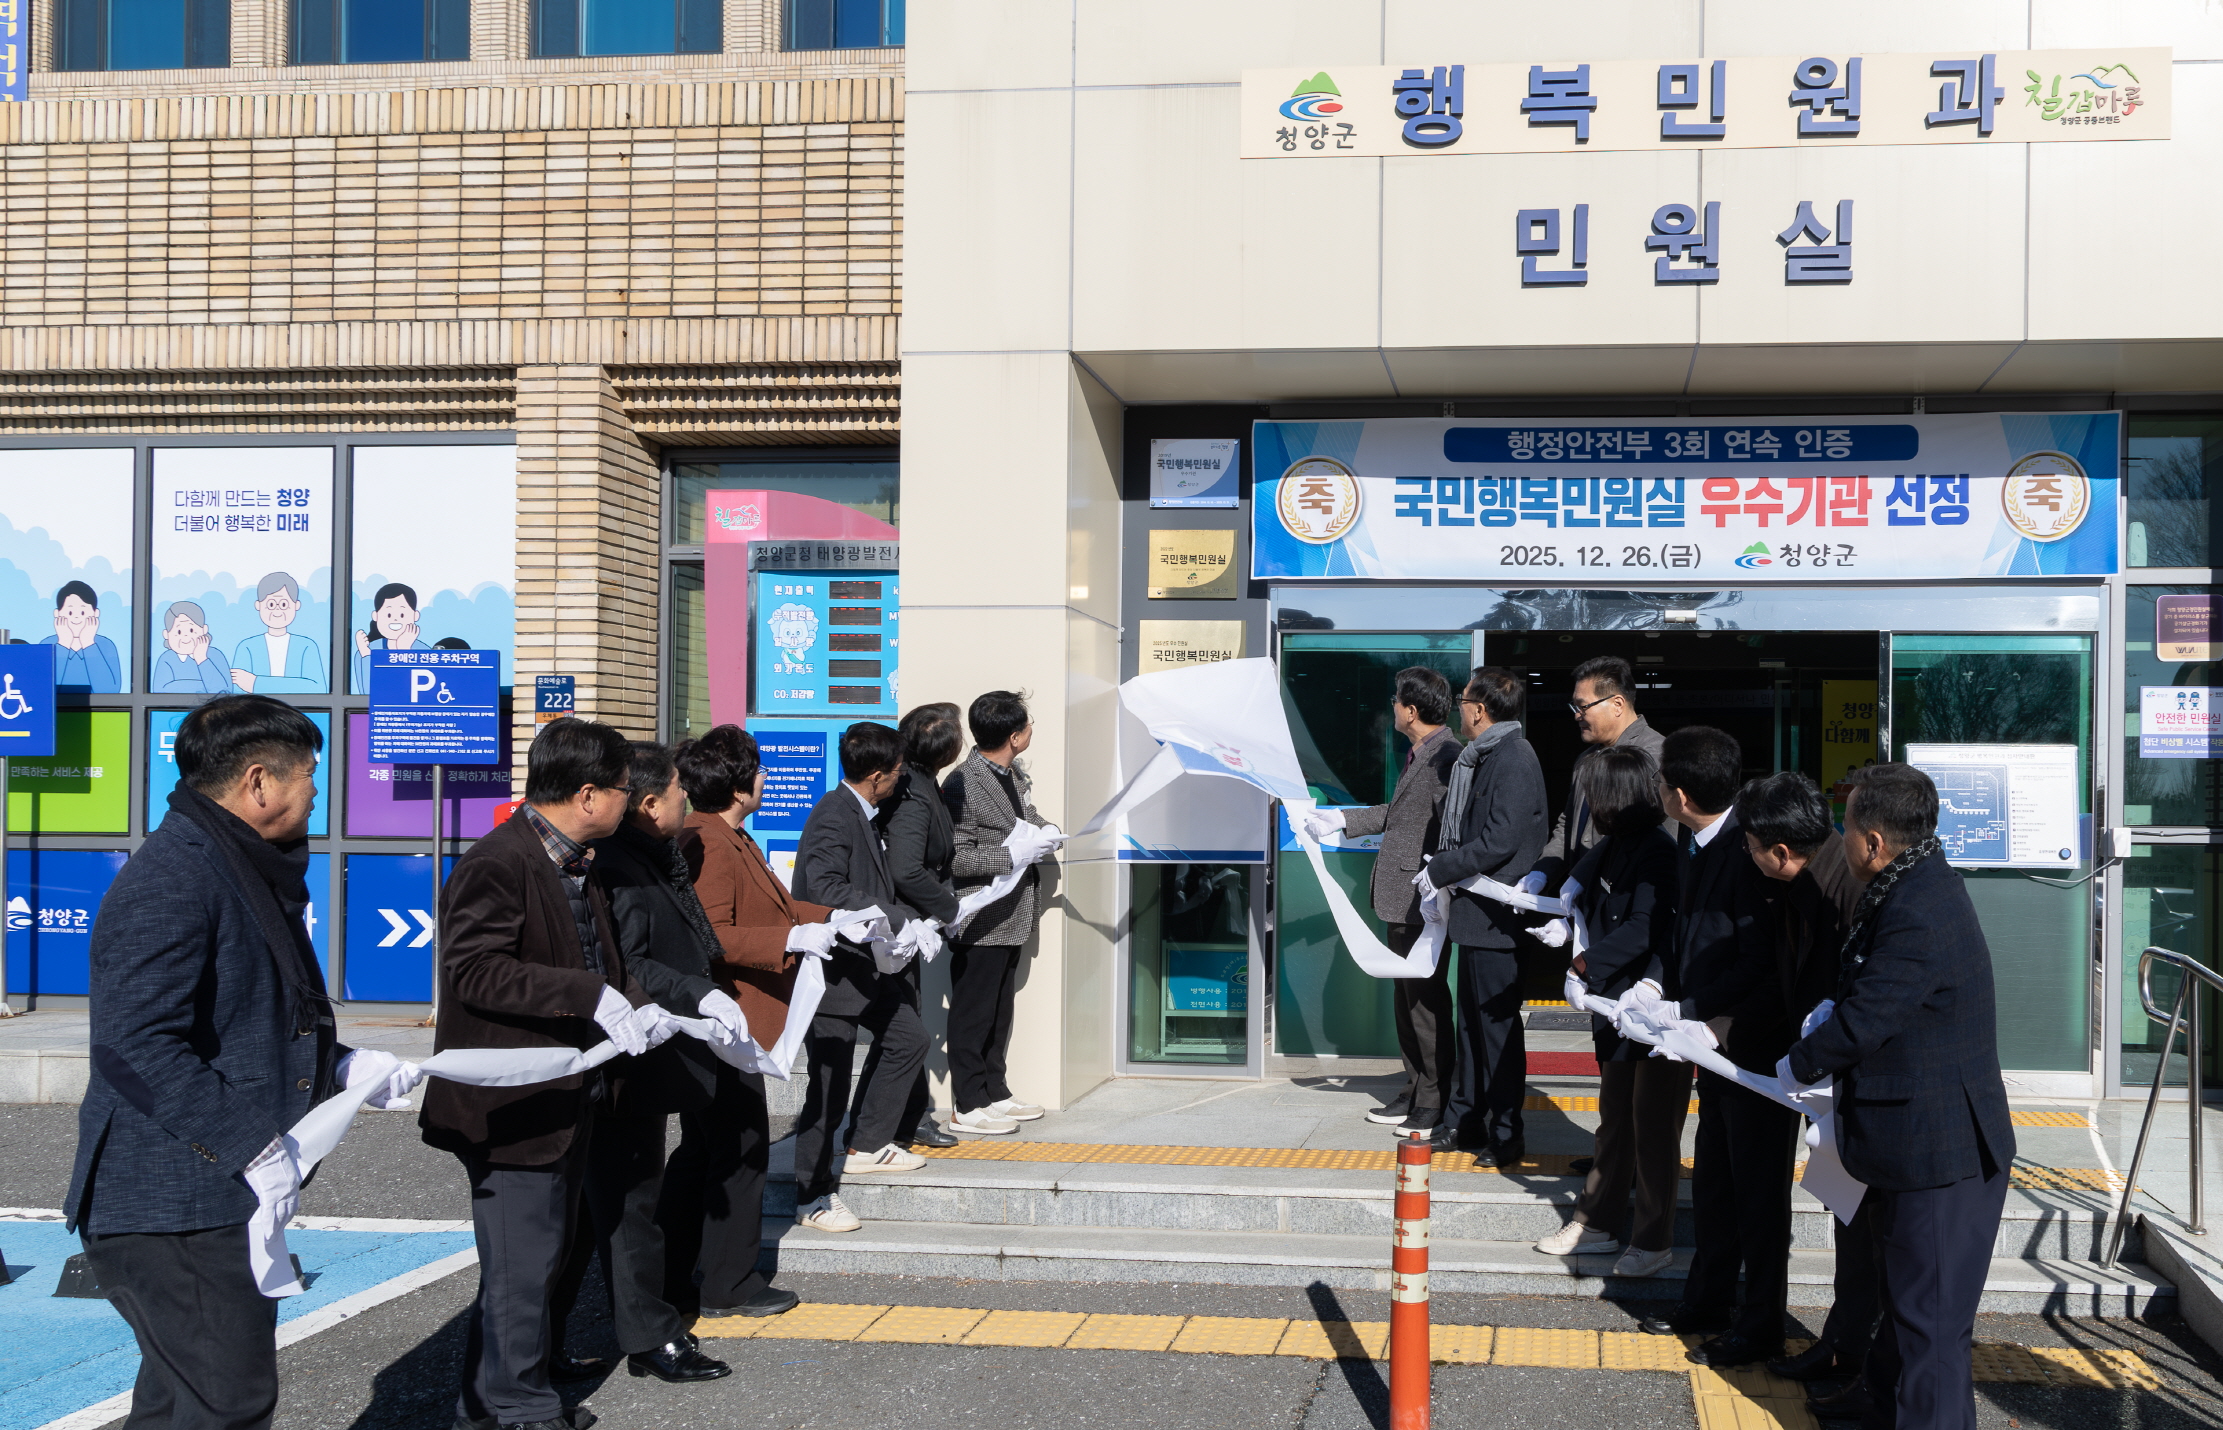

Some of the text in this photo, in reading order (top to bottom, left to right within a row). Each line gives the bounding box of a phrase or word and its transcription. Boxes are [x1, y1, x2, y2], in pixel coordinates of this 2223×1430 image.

[1393, 54, 2005, 148] 행복민원과
[1276, 122, 1357, 151] 청양군
[1517, 200, 1854, 288] 민원실
[1507, 428, 1853, 460] 행정안전부 3회 연속 인증
[1156, 459, 1221, 470] 국민행복민원실
[174, 488, 310, 507] 다함께 만드는 청양
[1298, 478, 1336, 515] 축
[1394, 474, 1970, 529] 국민행복민원실 우수기관 선정
[2023, 473, 2064, 512] 축
[174, 513, 309, 532] 더불어 행복한 미래
[756, 546, 811, 562] 청양군청
[1160, 554, 1226, 565] 국민행복민원실
[1500, 543, 1702, 569] 2025. 12. 26.(금)
[1779, 543, 1858, 568] 청양군
[388, 653, 480, 664] 장애인 전용 주차구역
[1152, 650, 1232, 662] 국민행복민원실
[411, 669, 436, 703] P
[537, 677, 568, 686] 문화예술로
[544, 693, 572, 708] 222
[1841, 702, 1878, 720] 청양
[2155, 712, 2221, 724] 안전한 민원실
[2143, 737, 2159, 746] 첨단
[2160, 737, 2184, 746] 비상벨
[2184, 737, 2209, 746] 시스템
[10, 766, 103, 778] 만족하는 서비스 제공
[368, 770, 390, 782] 각종
[392, 770, 422, 782] 민원을
[448, 771, 488, 783] 정확하게
[490, 771, 511, 783] 처리
[38, 908, 90, 927] 청양군
